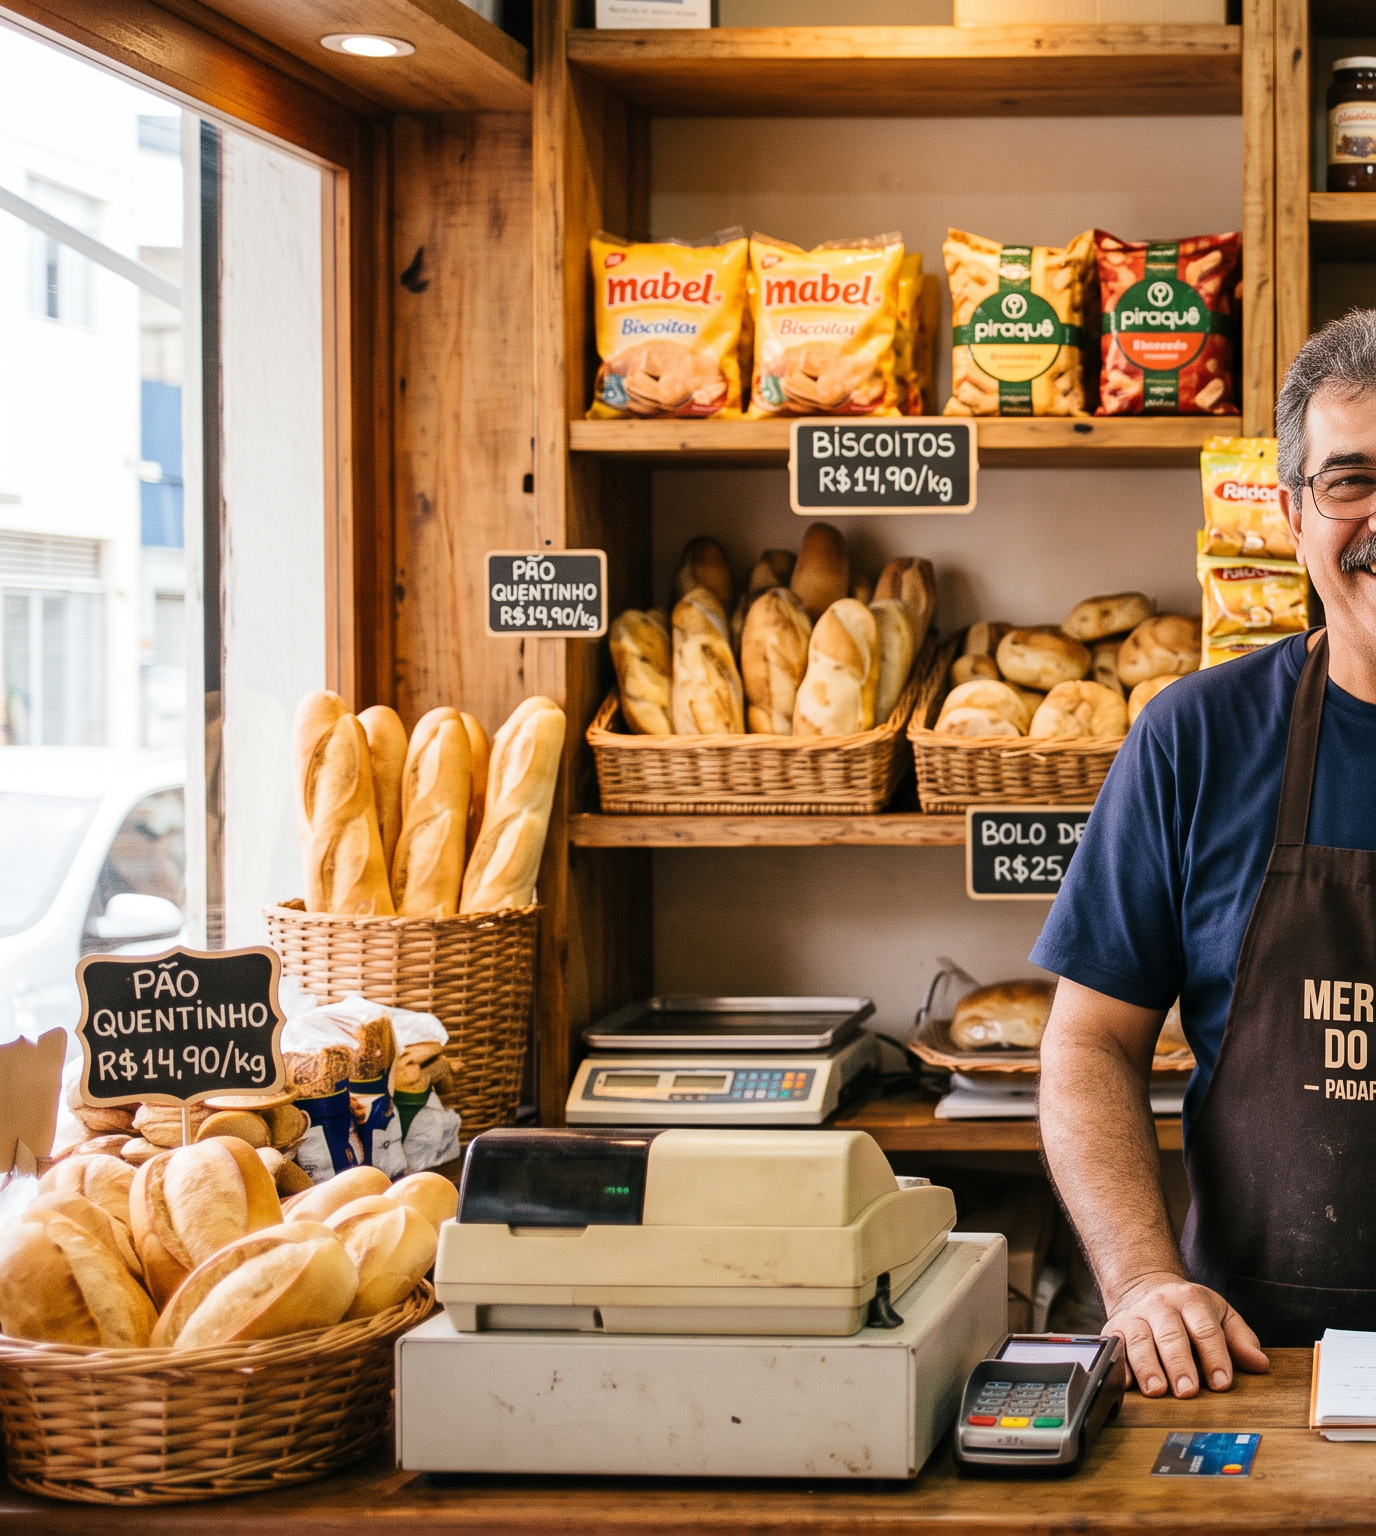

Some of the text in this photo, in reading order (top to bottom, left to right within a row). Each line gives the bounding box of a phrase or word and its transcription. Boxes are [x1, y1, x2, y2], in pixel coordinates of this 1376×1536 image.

[607, 271, 713, 306] mabel
[766, 272, 871, 307] mabel
[974, 318, 1054, 343] piraquê
[1120, 306, 1200, 331] piraquê
[818, 464, 953, 502] R$14,90/kg
[512, 554, 556, 581] PÃO
[491, 583, 598, 602] QUENTINHO
[981, 819, 1047, 846] BOLO
[133, 961, 199, 1000] PÃO
[93, 999, 268, 1038] QUENTINHO
[98, 1040, 266, 1083] R$14,90/kg
[1324, 1028, 1368, 1071] DO
